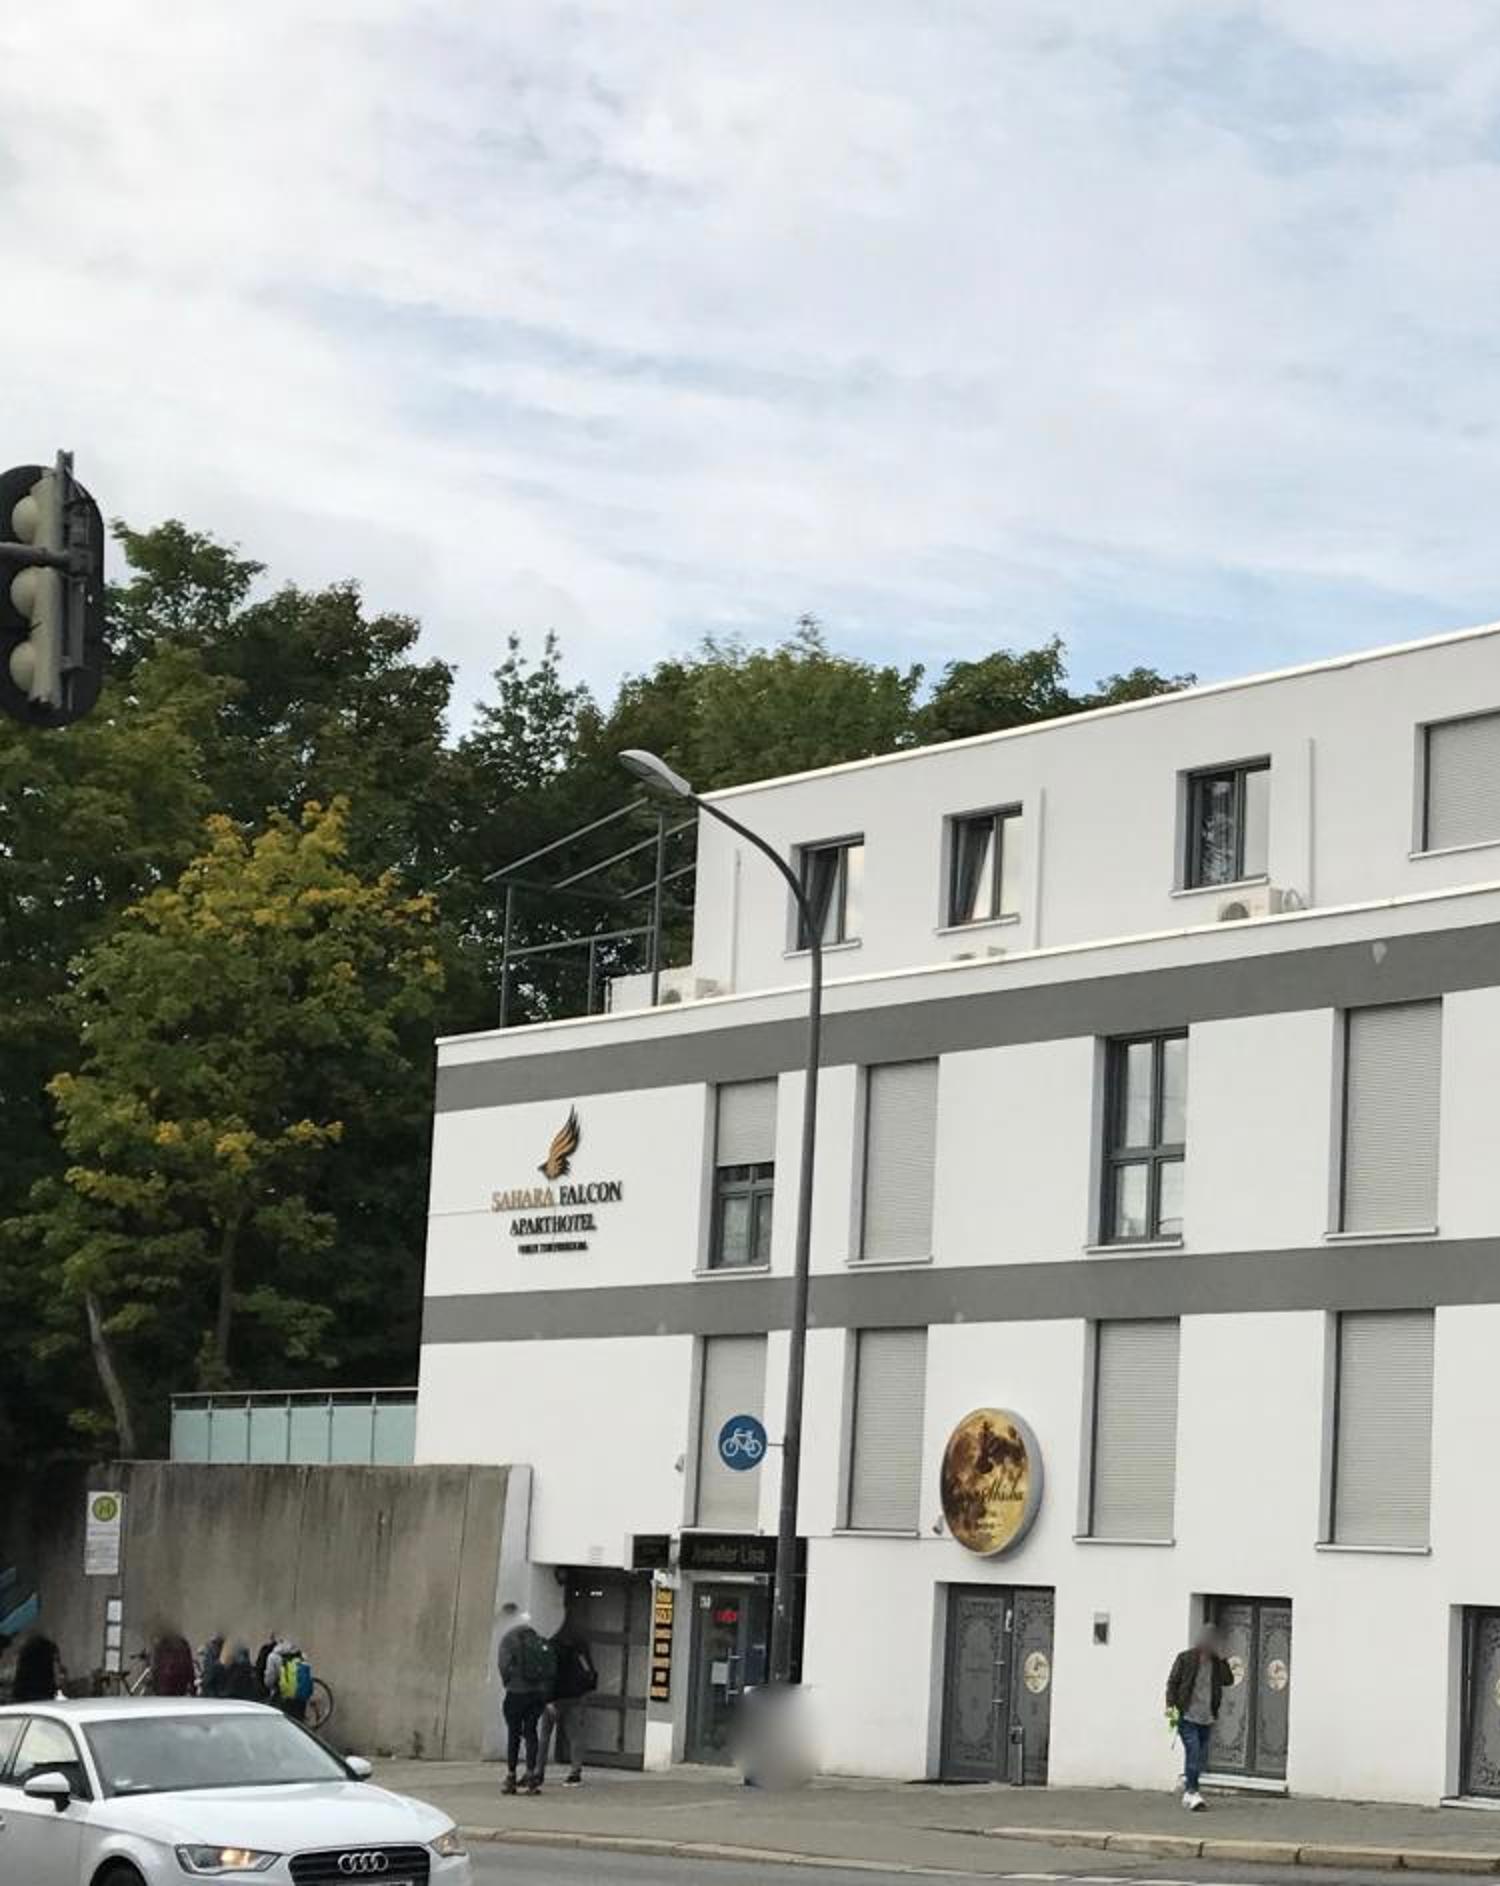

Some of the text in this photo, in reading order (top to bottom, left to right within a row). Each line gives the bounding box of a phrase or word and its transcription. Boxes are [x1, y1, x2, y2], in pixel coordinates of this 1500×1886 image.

[492, 1181, 622, 1213] SAHARA FALCON
[510, 1213, 597, 1236] APARTHOTEL
